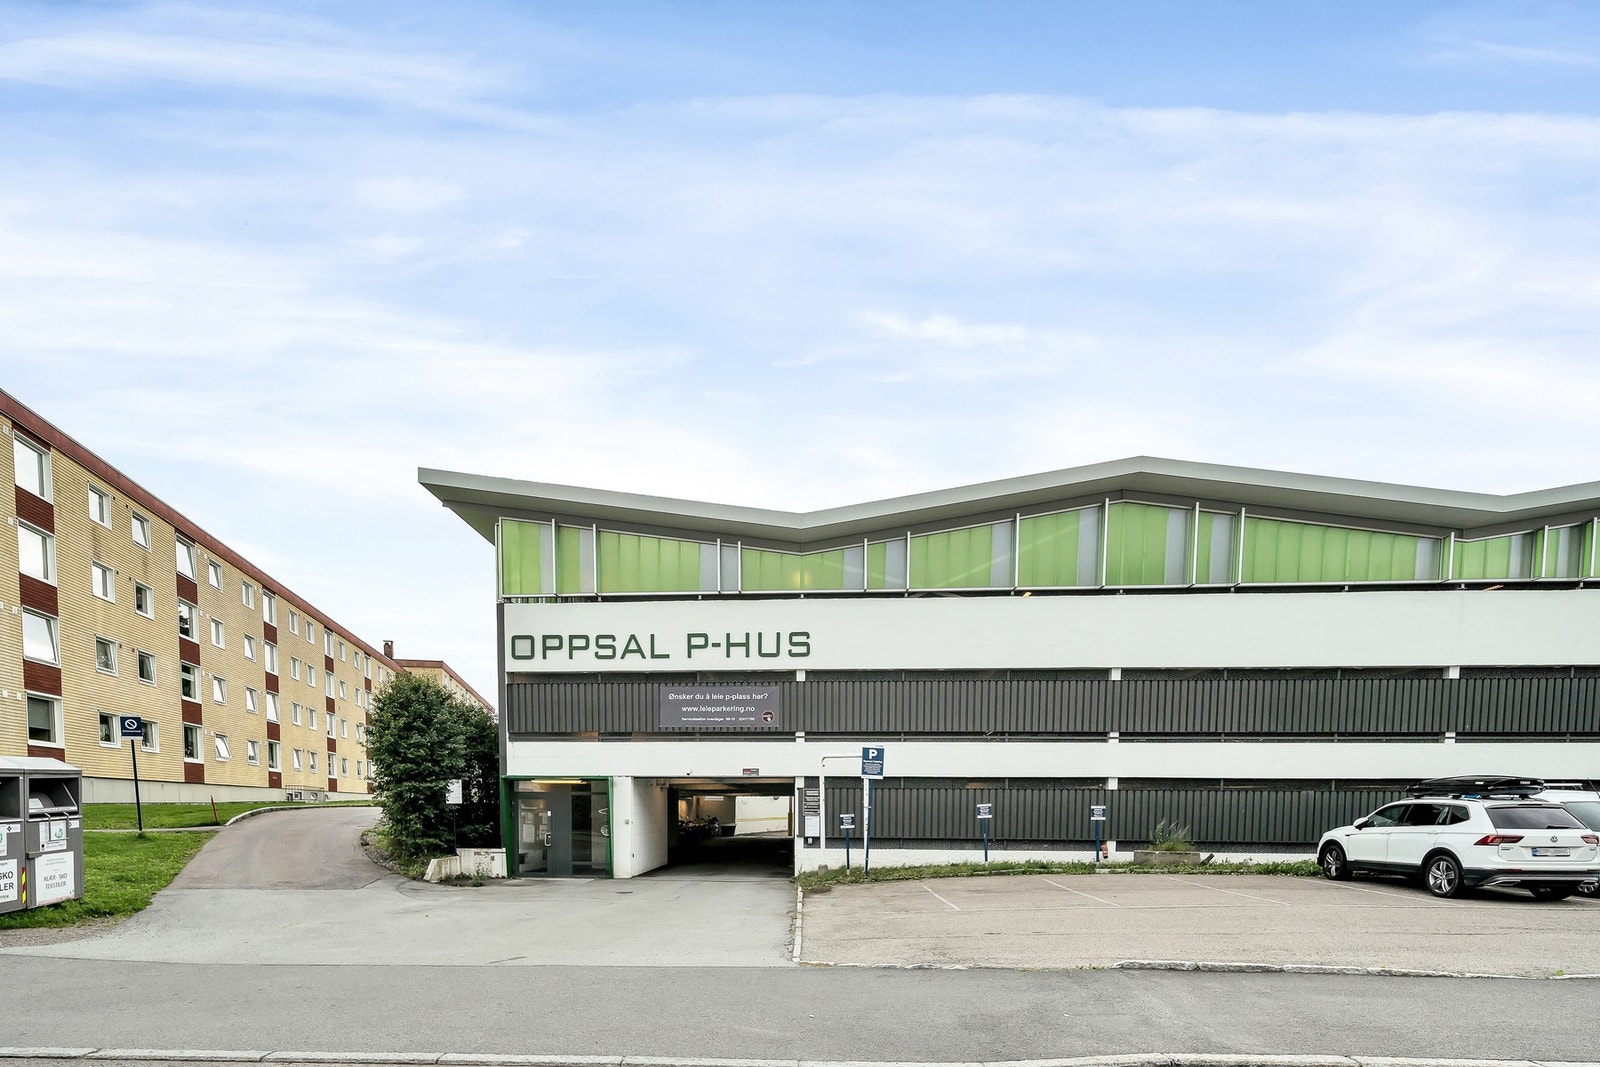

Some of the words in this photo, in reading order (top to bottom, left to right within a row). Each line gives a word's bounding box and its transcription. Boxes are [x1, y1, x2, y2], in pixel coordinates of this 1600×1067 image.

[511, 634, 670, 660] OPPSAL
[687, 632, 811, 658] P-HUS
[725, 693, 750, 701] p-plass
[681, 705, 755, 713] www.leieparkering.no
[869, 749, 878, 759] P
